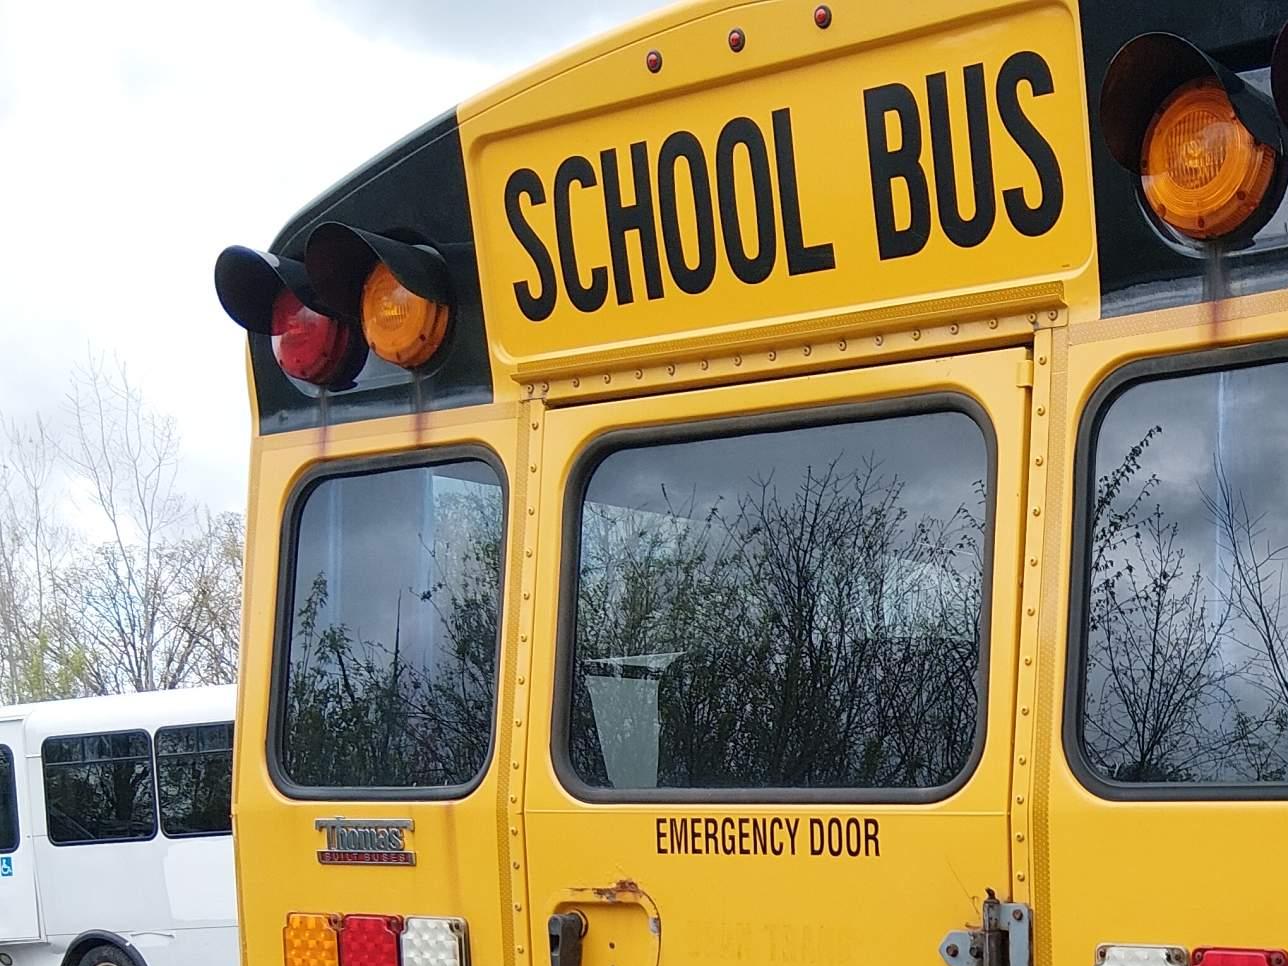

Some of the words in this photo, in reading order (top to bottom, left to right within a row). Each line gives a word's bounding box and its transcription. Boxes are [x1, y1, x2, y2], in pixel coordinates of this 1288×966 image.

[504, 108, 836, 322] SCHOOL
[863, 51, 1065, 262] BUS
[314, 816, 416, 850] Thomas
[655, 816, 800, 856] EMERGENCY
[809, 817, 881, 857] DOOR
[323, 851, 359, 861] BUILT
[364, 852, 406, 862] BUSES
